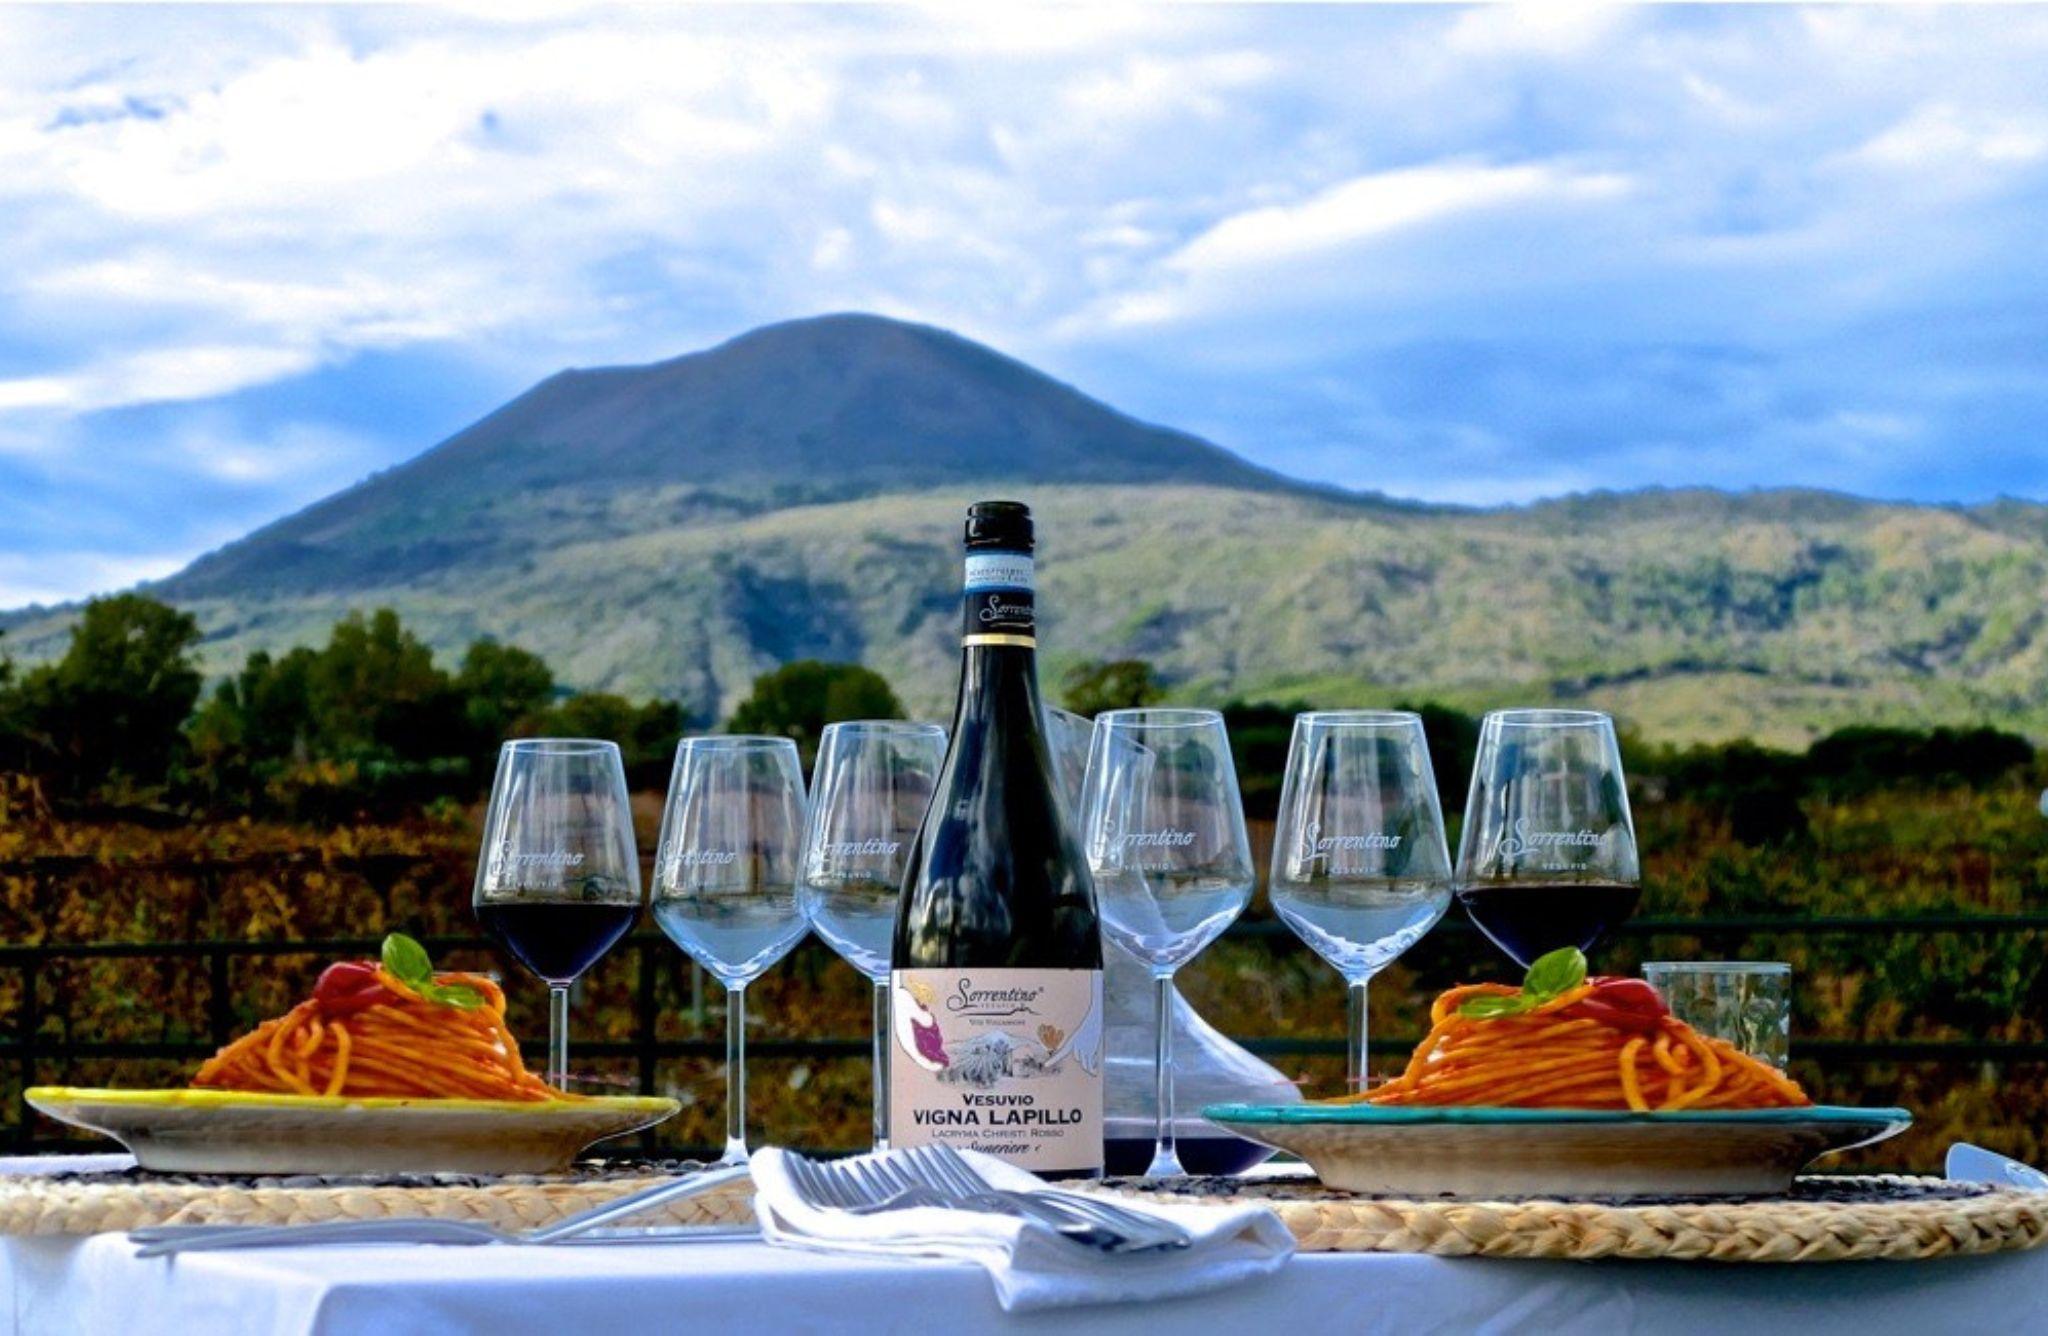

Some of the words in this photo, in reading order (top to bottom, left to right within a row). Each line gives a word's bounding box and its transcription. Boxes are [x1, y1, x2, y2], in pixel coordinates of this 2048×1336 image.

[1300, 822, 1402, 862] Sorrentino
[1500, 817, 1608, 857] Sorrentino
[947, 978, 1038, 1012] Sorrentino
[962, 1093, 1034, 1107] VESUVIO
[913, 1109, 980, 1126] VIGNA
[989, 1109, 1083, 1126] LAPILLO
[932, 1128, 979, 1138] LACRYMA
[982, 1128, 1026, 1138] CHRISTI
[1031, 1128, 1065, 1138] ROSSO
